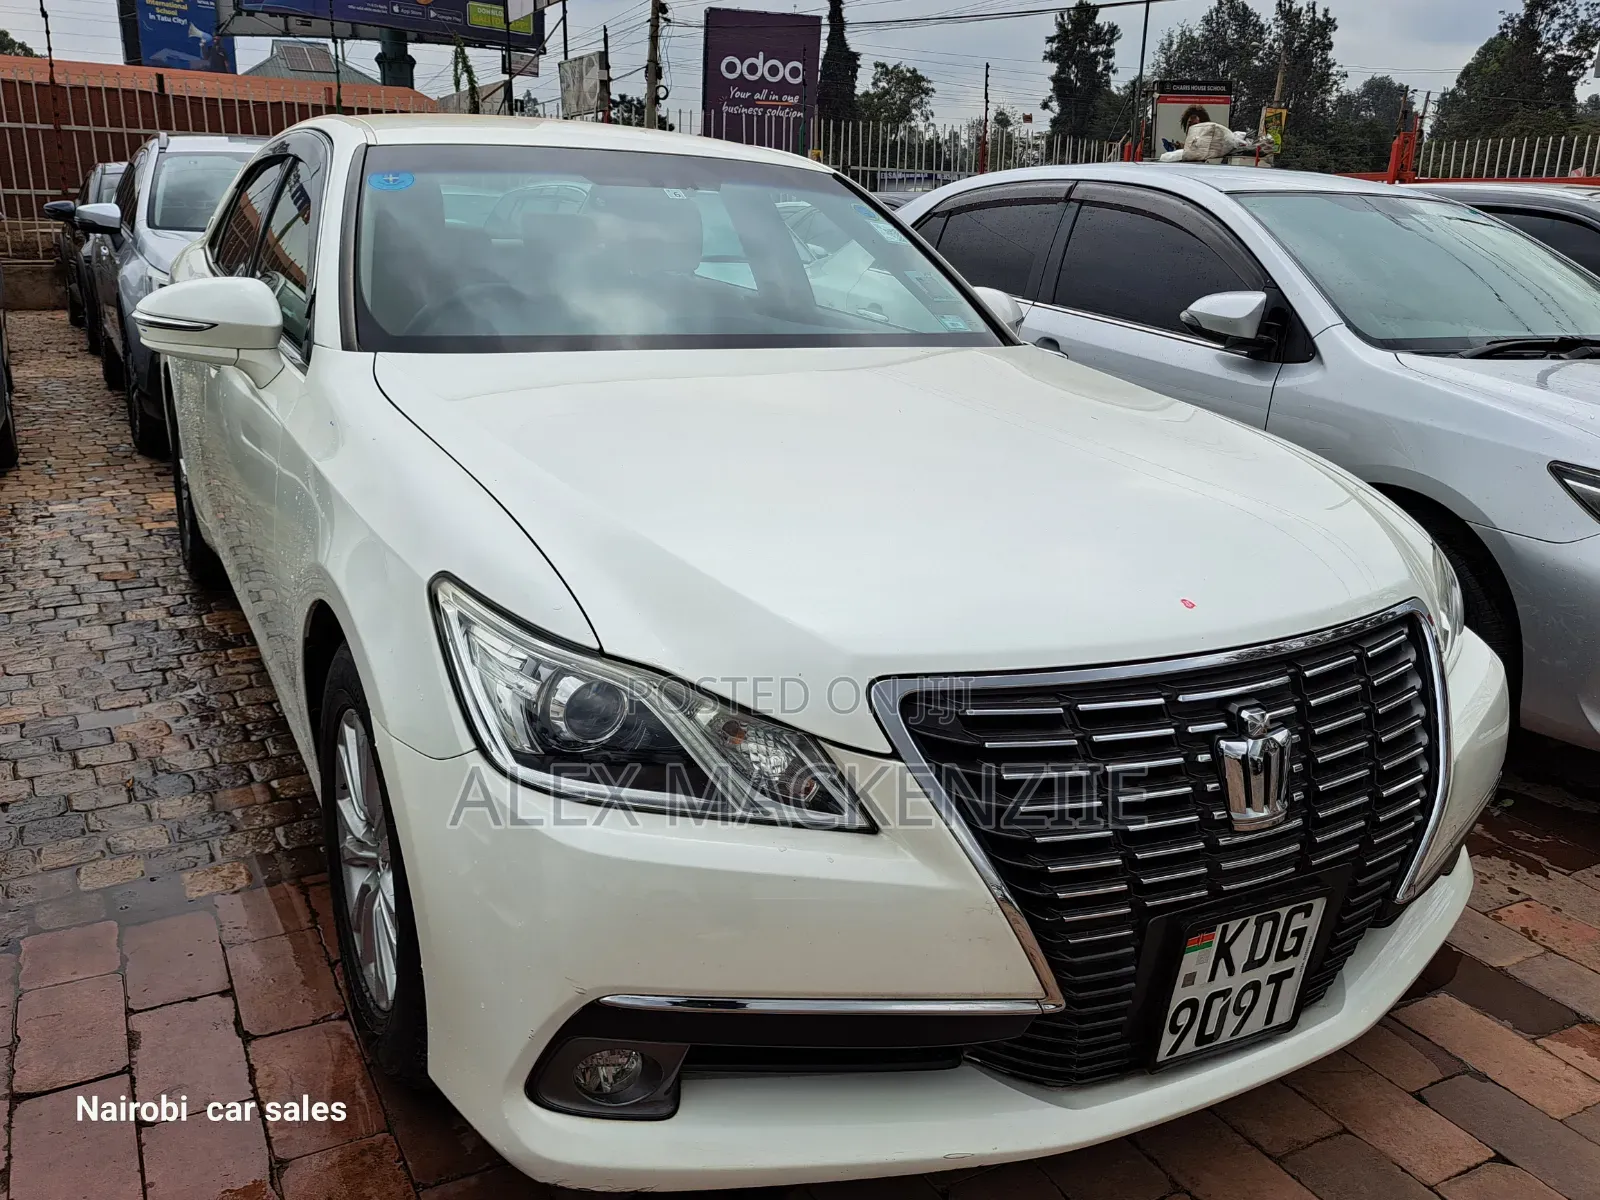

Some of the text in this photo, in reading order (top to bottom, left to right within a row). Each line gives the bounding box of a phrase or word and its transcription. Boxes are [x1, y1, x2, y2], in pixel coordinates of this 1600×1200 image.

[720, 52, 803, 84] odoo
[730, 86, 752, 99] Your
[754, 89, 768, 100] all
[769, 91, 778, 101] in
[722, 102, 804, 118] business solution
[1208, 902, 1314, 982] KDG
[1166, 967, 1295, 1056] 909T
